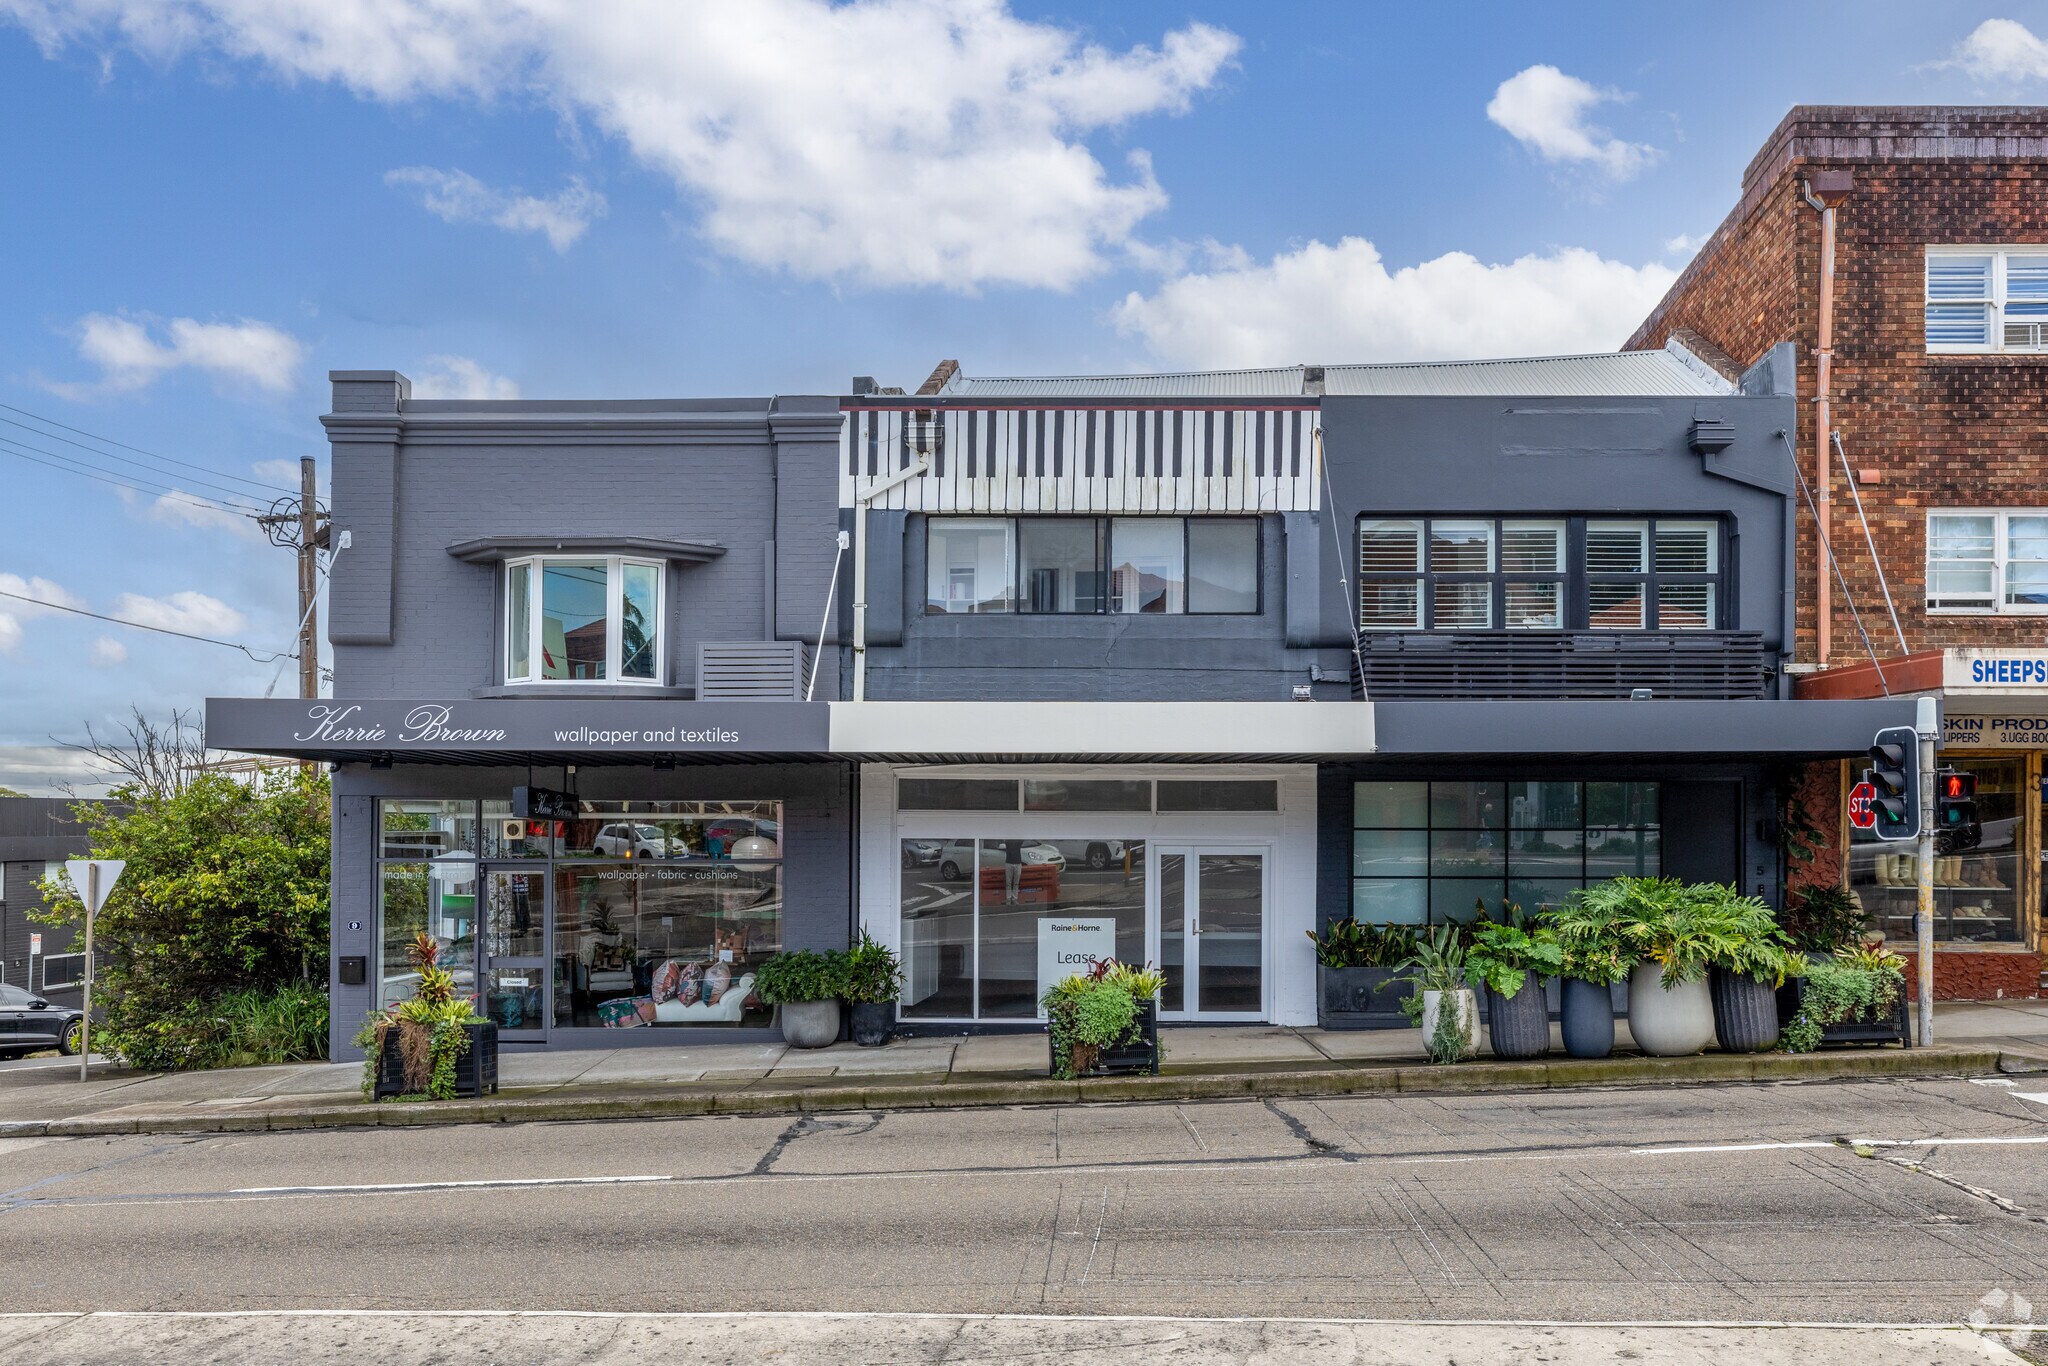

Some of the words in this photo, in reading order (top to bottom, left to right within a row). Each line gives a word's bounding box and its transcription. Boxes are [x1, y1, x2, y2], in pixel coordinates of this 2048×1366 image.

[1972, 659, 2048, 683] SHEEPS
[294, 705, 387, 742] Kerrie
[398, 704, 507, 742] Brown
[1992, 718, 2048, 731] PROD
[554, 726, 639, 746] wallpaper
[643, 726, 675, 743] and
[680, 726, 740, 743] textiles
[2031, 773, 2041, 791] 3
[1851, 797, 1875, 813] STO
[384, 868, 413, 879] made
[415, 868, 424, 879] in
[597, 869, 649, 881] wallpaper
[657, 869, 687, 880] fabric
[694, 869, 738, 880] cushions
[1756, 865, 1765, 876] 5
[1051, 924, 1102, 932] Raine&Horne
[1057, 951, 1097, 964] Lease
